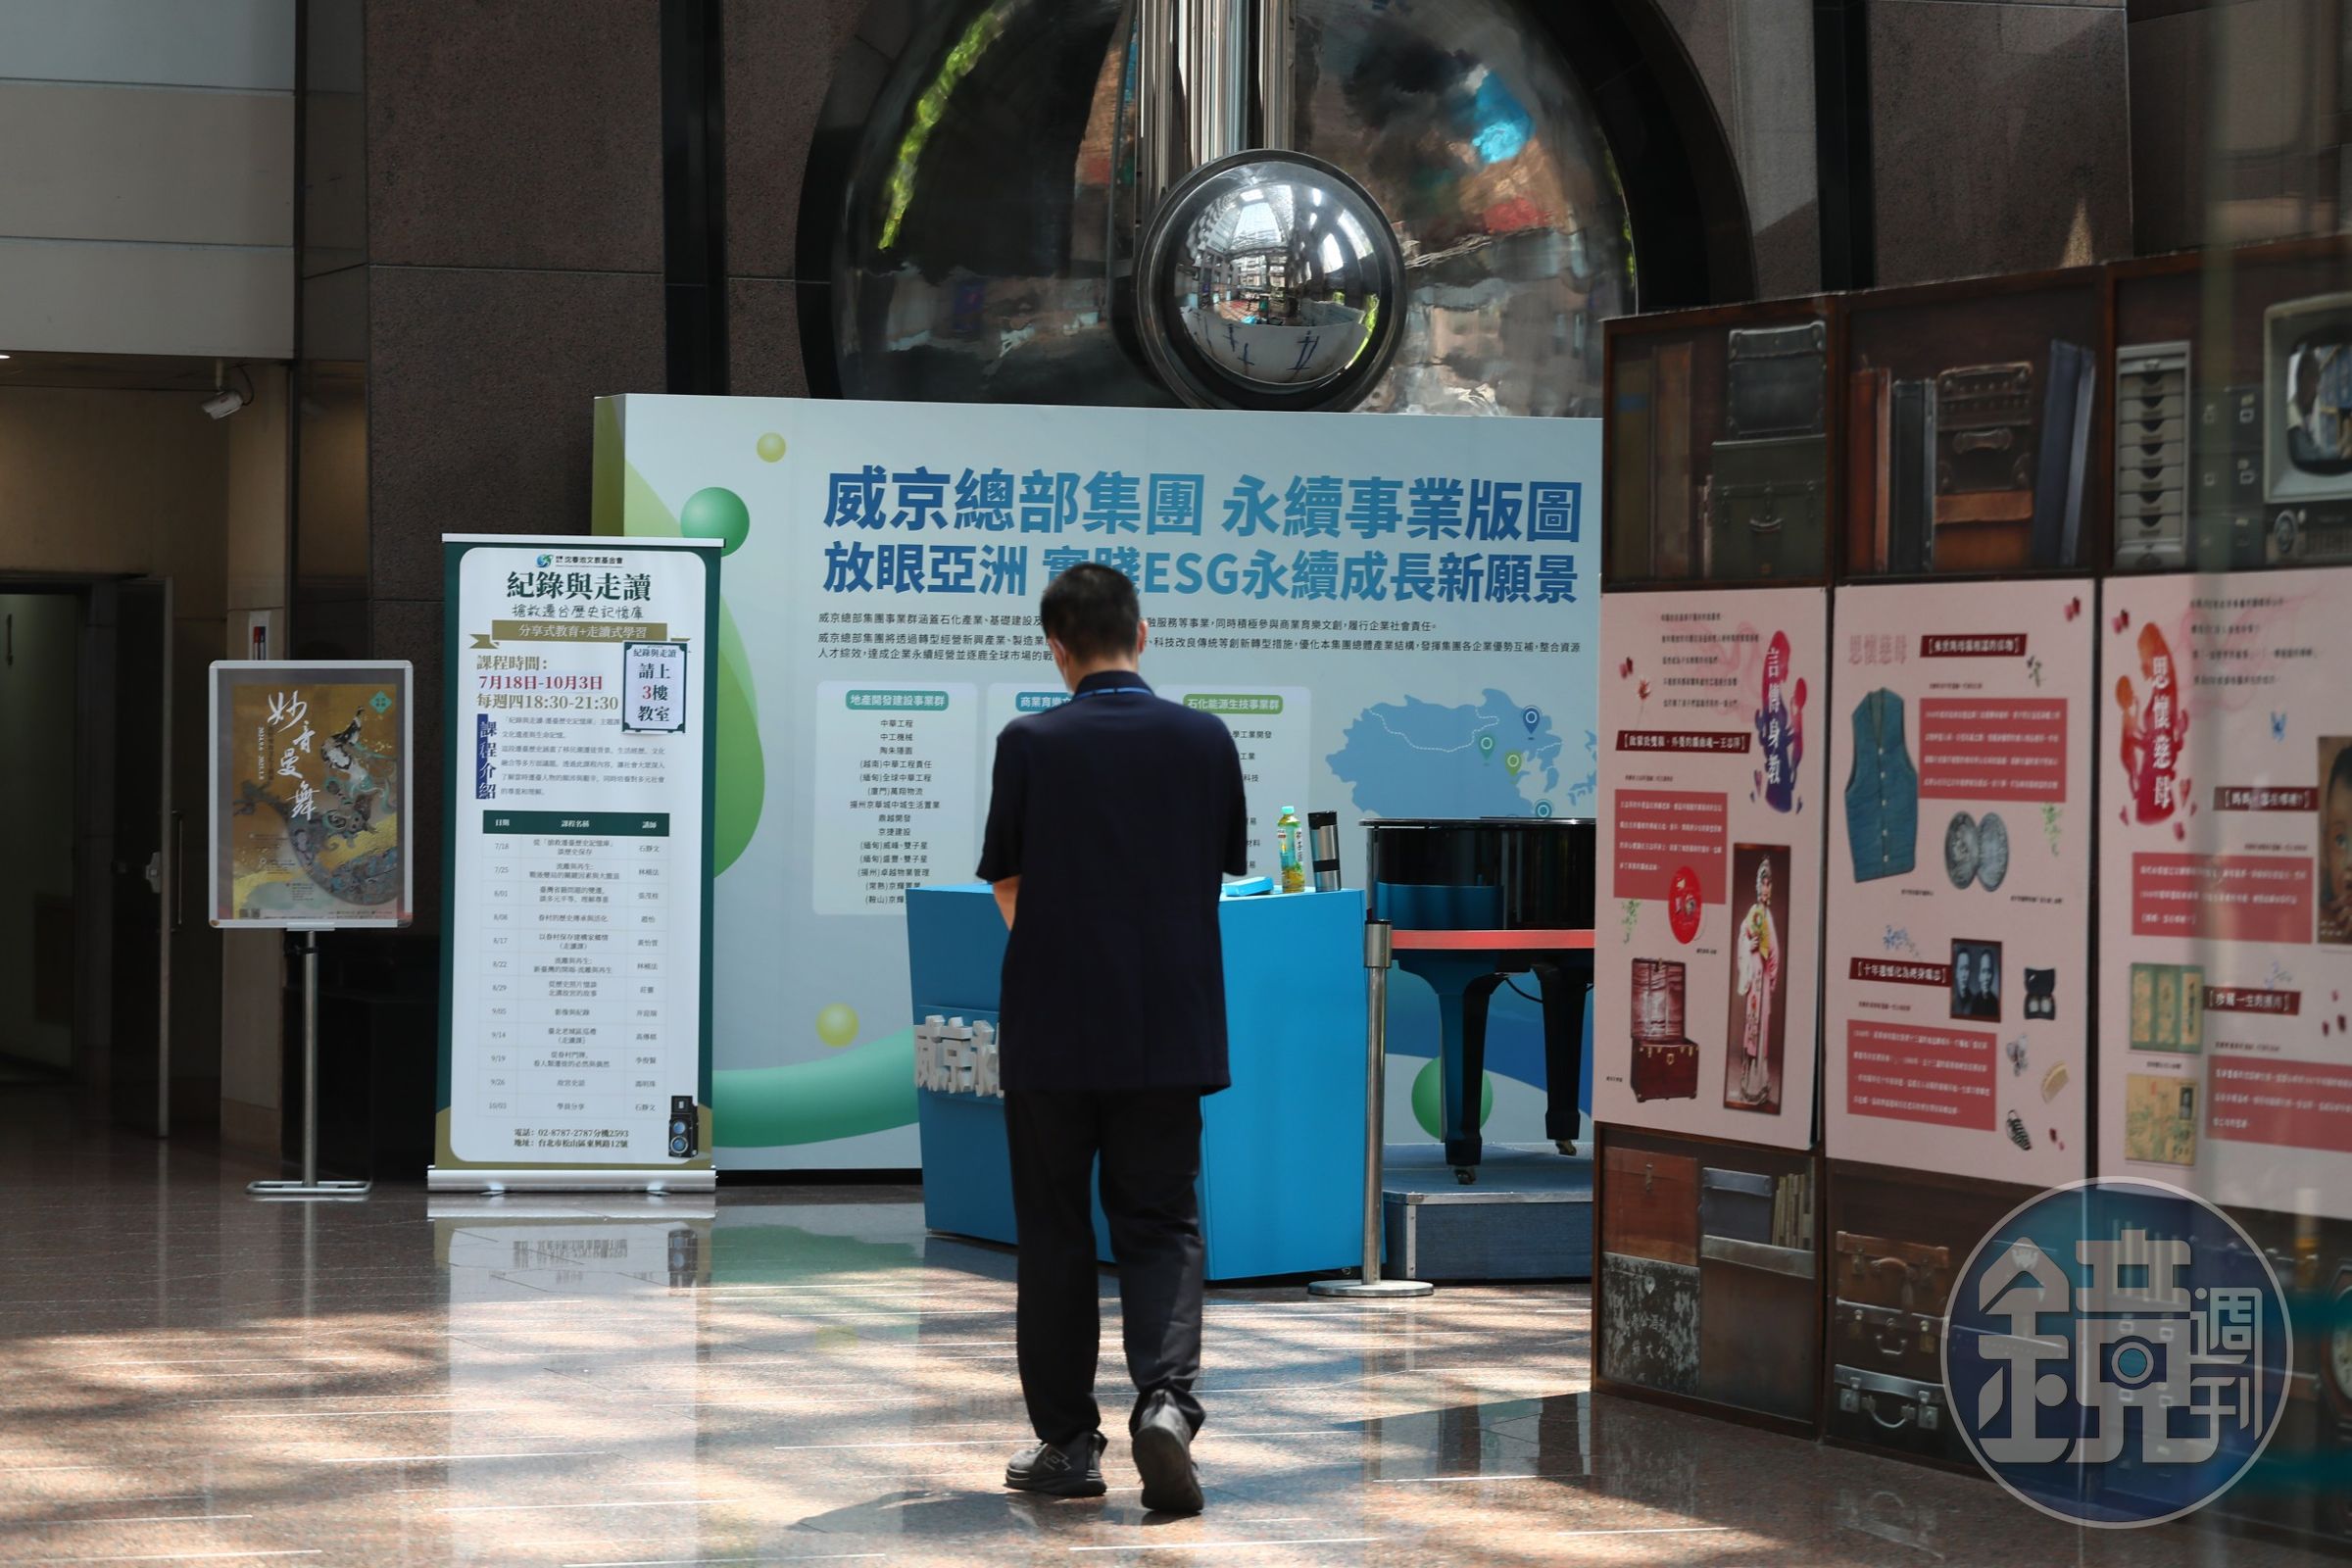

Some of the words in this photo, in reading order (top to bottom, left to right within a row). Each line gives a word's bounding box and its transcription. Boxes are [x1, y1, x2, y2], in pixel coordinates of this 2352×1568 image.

[822, 465, 1204, 536] 威京總部集團
[1221, 474, 1582, 543] 永續事業版圖
[823, 540, 1027, 596] 放眼亞洲
[507, 570, 651, 601] 紀錄與走讀
[512, 605, 643, 619] 搶救遷台歷史記憶庫
[519, 623, 647, 639] 分享式教育+走讀式學習
[638, 662, 671, 680] 請上
[478, 675, 603, 691] 7月18日-10月3日
[477, 694, 619, 710] 每週四18:30-21:30
[642, 684, 668, 702] 3樓
[638, 705, 671, 723] 教室
[479, 720, 497, 800] 課程介紹
